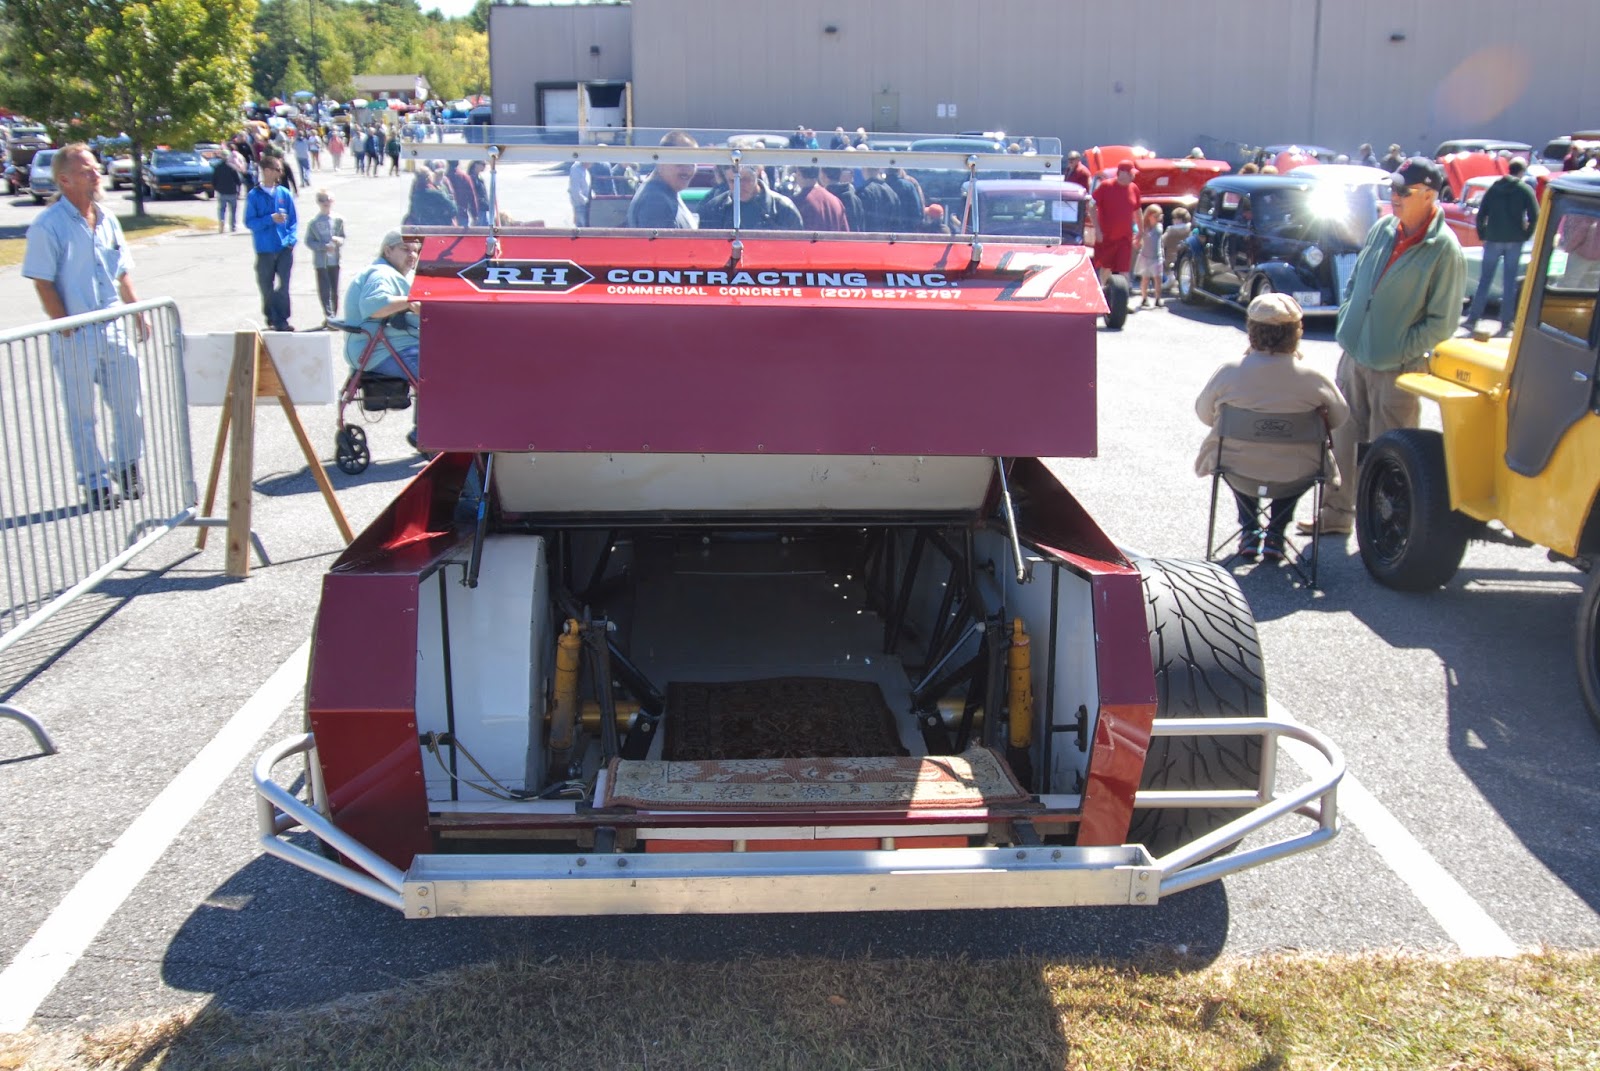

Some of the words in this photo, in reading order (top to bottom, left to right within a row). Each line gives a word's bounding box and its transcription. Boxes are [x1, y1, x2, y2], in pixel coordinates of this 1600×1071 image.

[483, 267, 569, 285] RH
[607, 269, 868, 287] CONTRACTING
[885, 272, 959, 288] INC.
[998, 250, 1086, 301] 7
[607, 285, 707, 296] COMMERCIAL
[718, 286, 803, 298] CONCRETE
[819, 288, 867, 300] (207)
